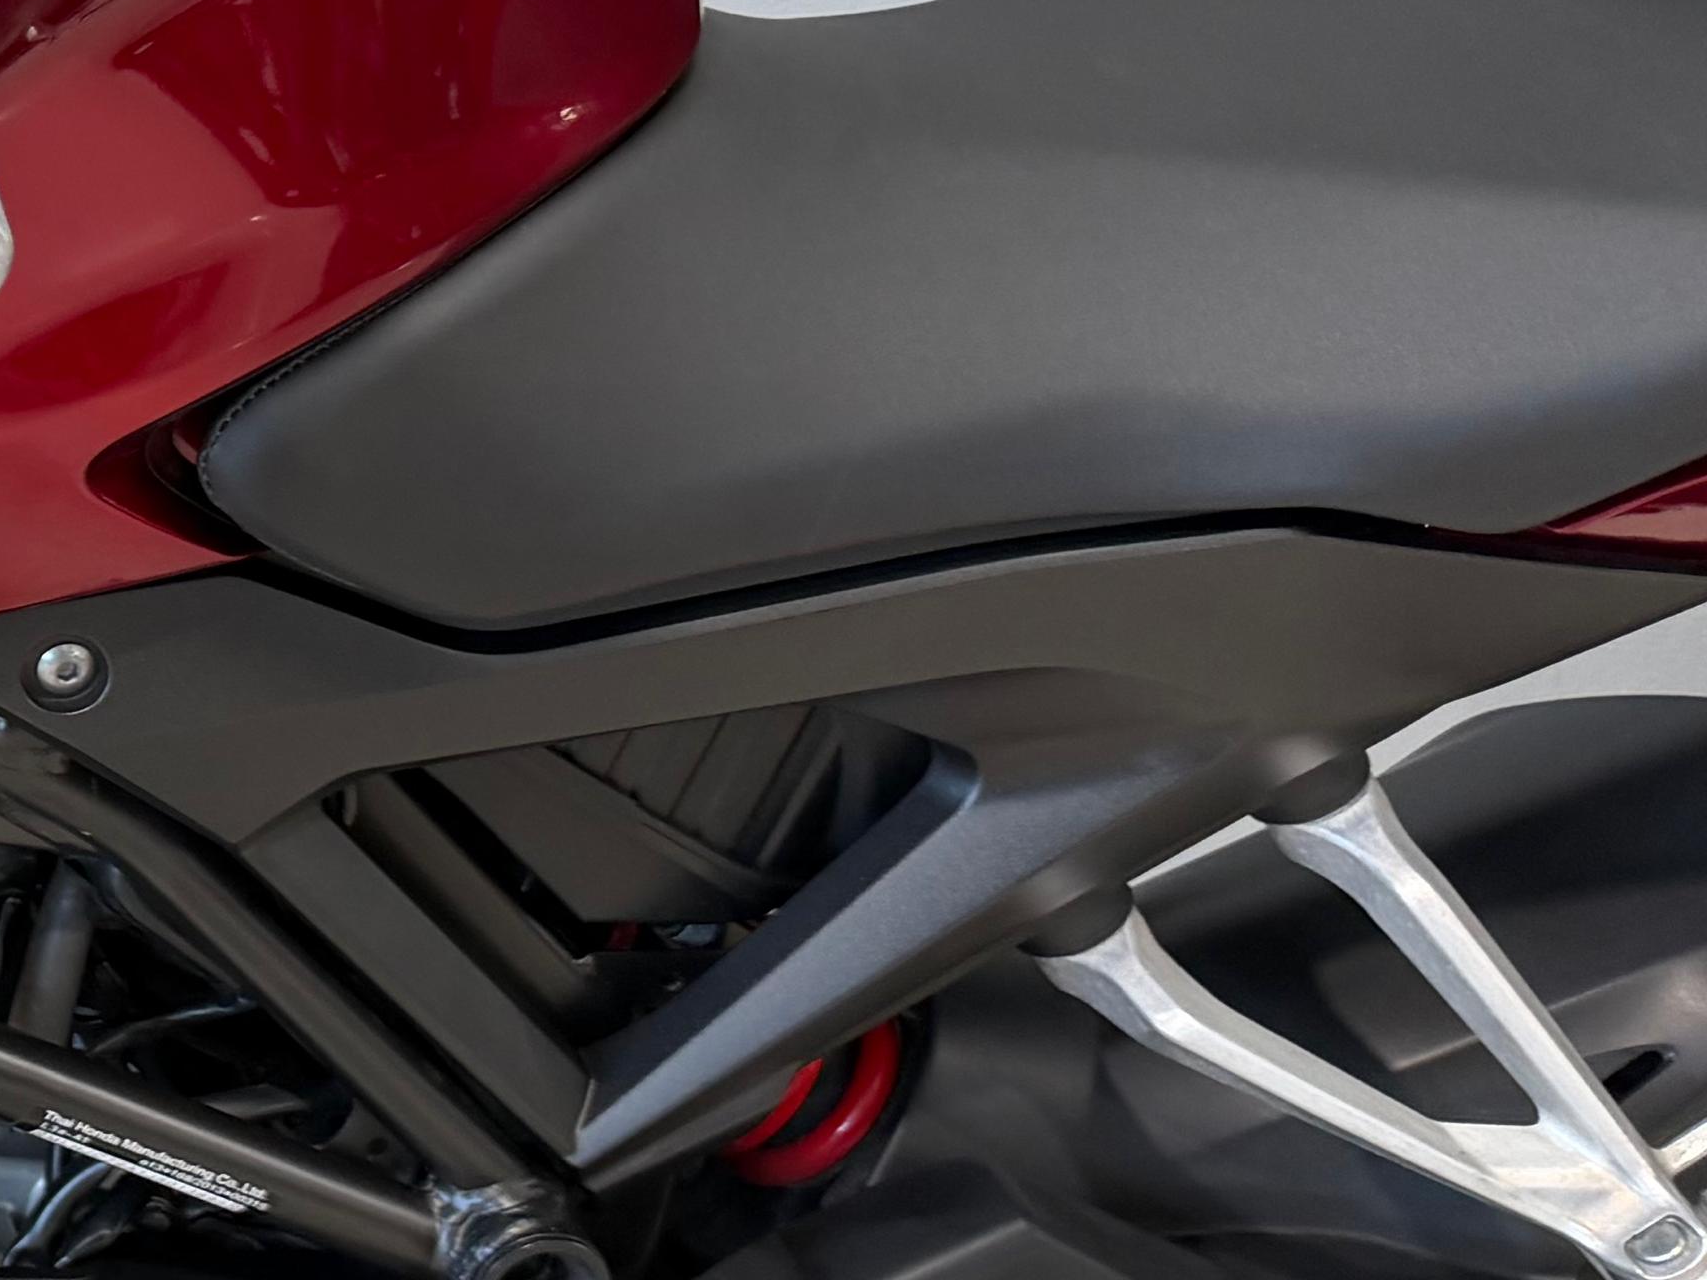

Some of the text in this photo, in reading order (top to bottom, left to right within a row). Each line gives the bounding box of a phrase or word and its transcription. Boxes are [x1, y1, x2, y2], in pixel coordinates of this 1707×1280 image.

[43, 1109, 75, 1129] Thai
[74, 1121, 121, 1146] Honda
[120, 1138, 216, 1181] Manufacturing
